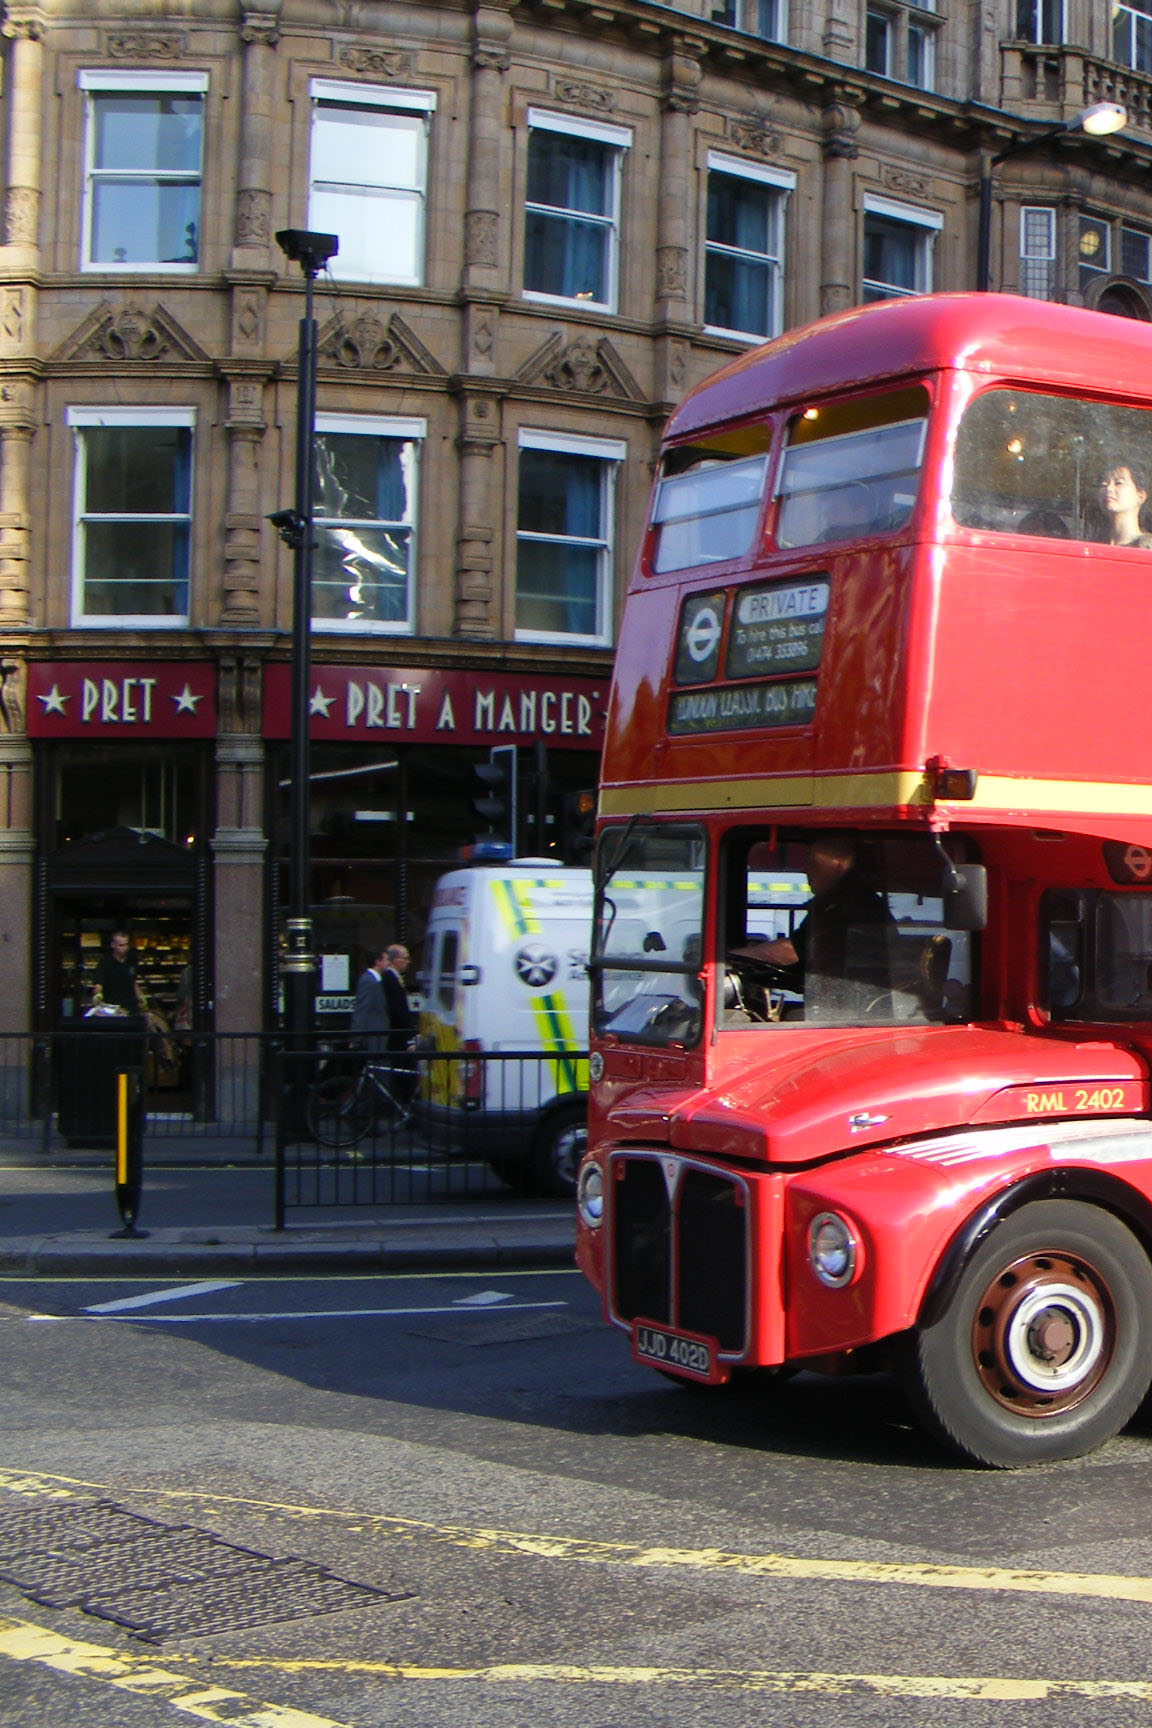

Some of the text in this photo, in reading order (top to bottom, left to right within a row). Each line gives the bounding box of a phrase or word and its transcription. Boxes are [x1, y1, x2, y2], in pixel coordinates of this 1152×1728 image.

[750, 588, 819, 617] PRIVATE
[82, 678, 156, 722] PRET
[346, 681, 592, 735] PRET A MANGER
[1027, 1089, 1124, 1112] RML 2402
[638, 1330, 709, 1370] JJD 402D
